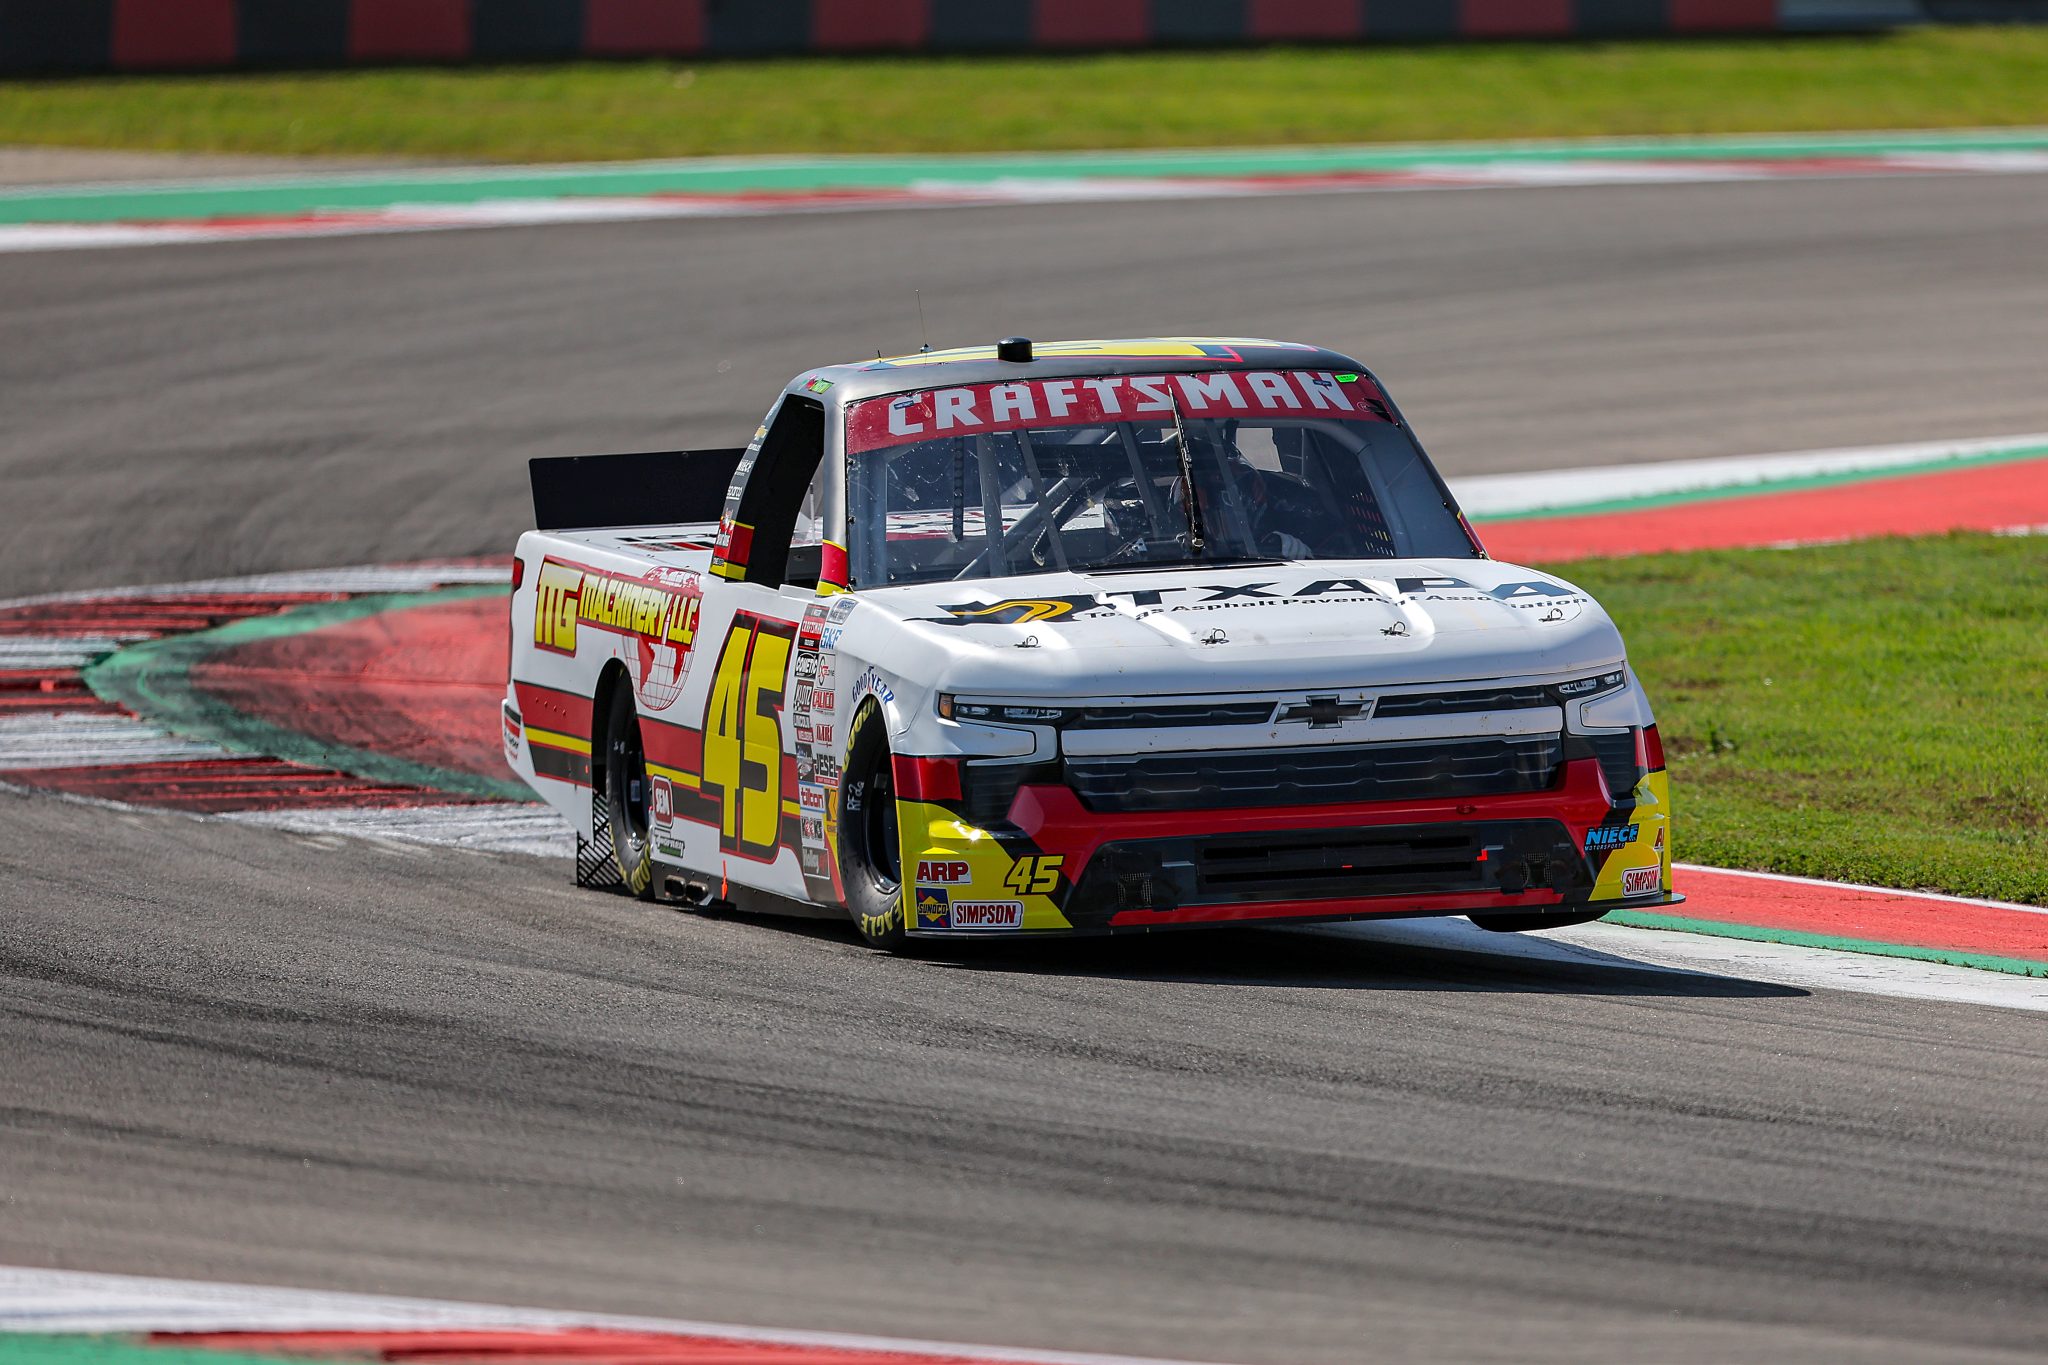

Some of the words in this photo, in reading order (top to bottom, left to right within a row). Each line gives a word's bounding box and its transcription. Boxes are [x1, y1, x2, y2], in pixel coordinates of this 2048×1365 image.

[889, 371, 1355, 436] CRAFTSMAN
[1105, 577, 1578, 605] TXAPA
[579, 574, 674, 638] MACHINERY
[667, 594, 700, 645] LLC
[1085, 608, 1164, 621] Teas
[1171, 600, 1276, 612] Asphalt
[820, 627, 842, 650] SKF
[852, 668, 894, 705] GOODYEAR
[812, 690, 835, 709] CALICO
[703, 626, 791, 848] 45
[815, 753, 838, 778] JESEL
[1584, 843, 1625, 851] MOTORSPORTS
[916, 861, 969, 882] ARP
[1006, 855, 1064, 894] 45
[1625, 869, 1659, 893] SIMPSON
[918, 903, 948, 915] SUNOCO
[956, 904, 1017, 925] SIMPSON
